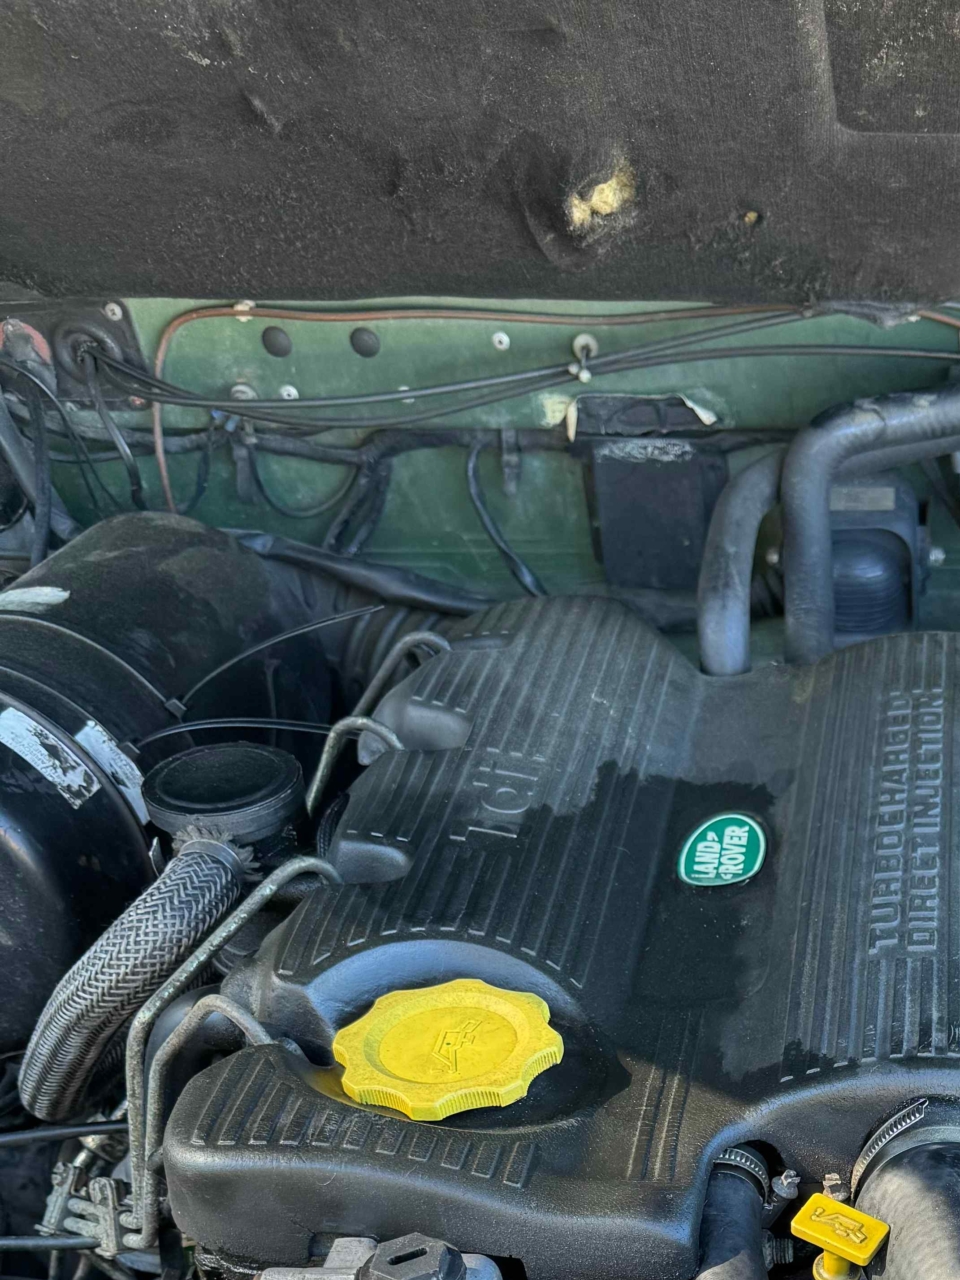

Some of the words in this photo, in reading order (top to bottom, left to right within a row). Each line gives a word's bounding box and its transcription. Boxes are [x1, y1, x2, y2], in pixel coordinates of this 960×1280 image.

[691, 839, 721, 878] LAND
[718, 826, 750, 874] ROVER
[906, 846, 940, 951] DIRECT
